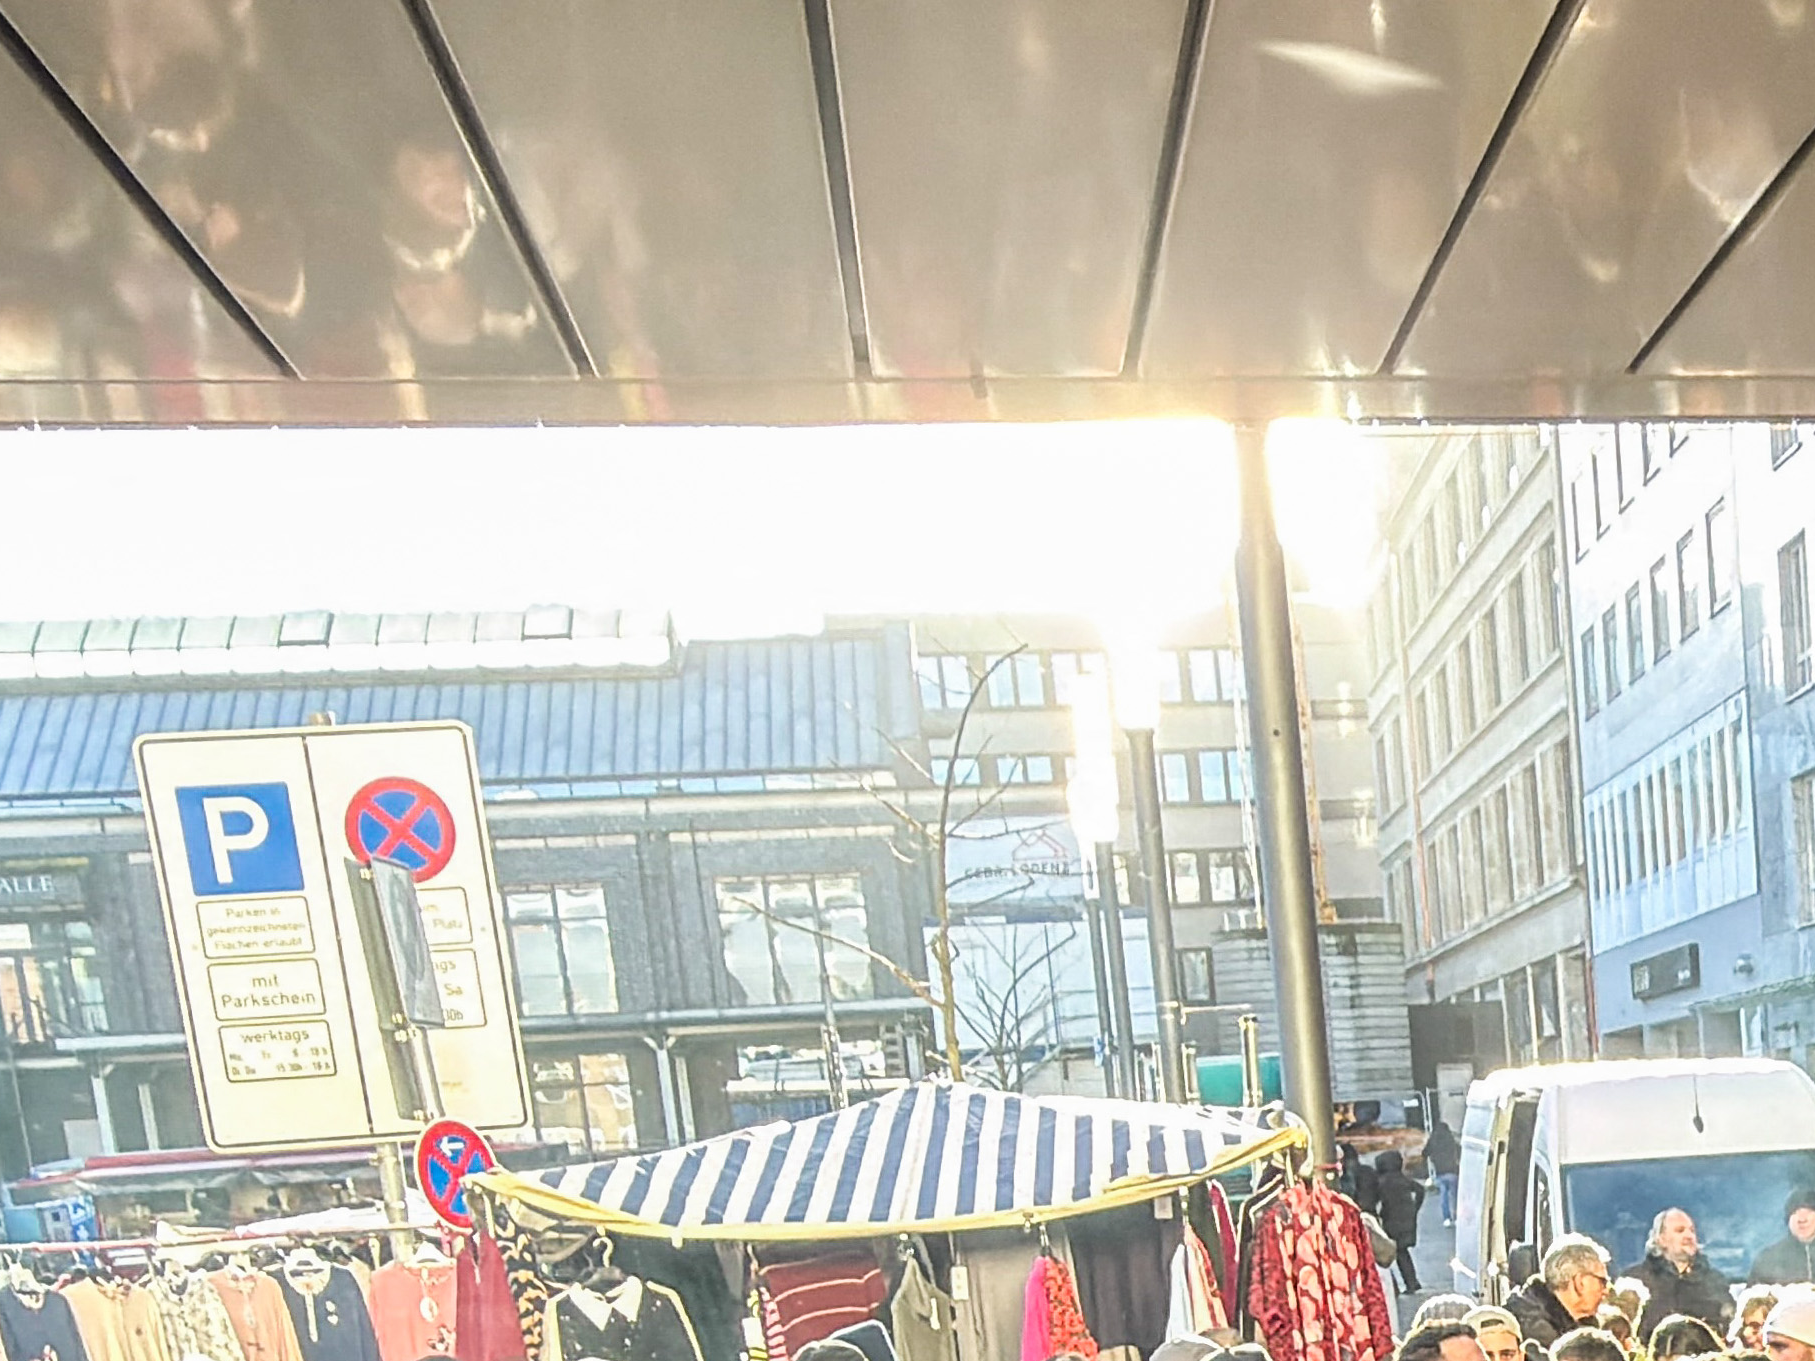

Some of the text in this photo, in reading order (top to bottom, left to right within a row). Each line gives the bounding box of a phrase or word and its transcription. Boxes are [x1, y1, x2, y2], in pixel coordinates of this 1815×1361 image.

[202, 796, 269, 884] P
[252, 974, 280, 988] mit
[444, 984, 463, 997] Sa
[221, 992, 316, 1008] Parkschein
[240, 1029, 310, 1045] werktags
